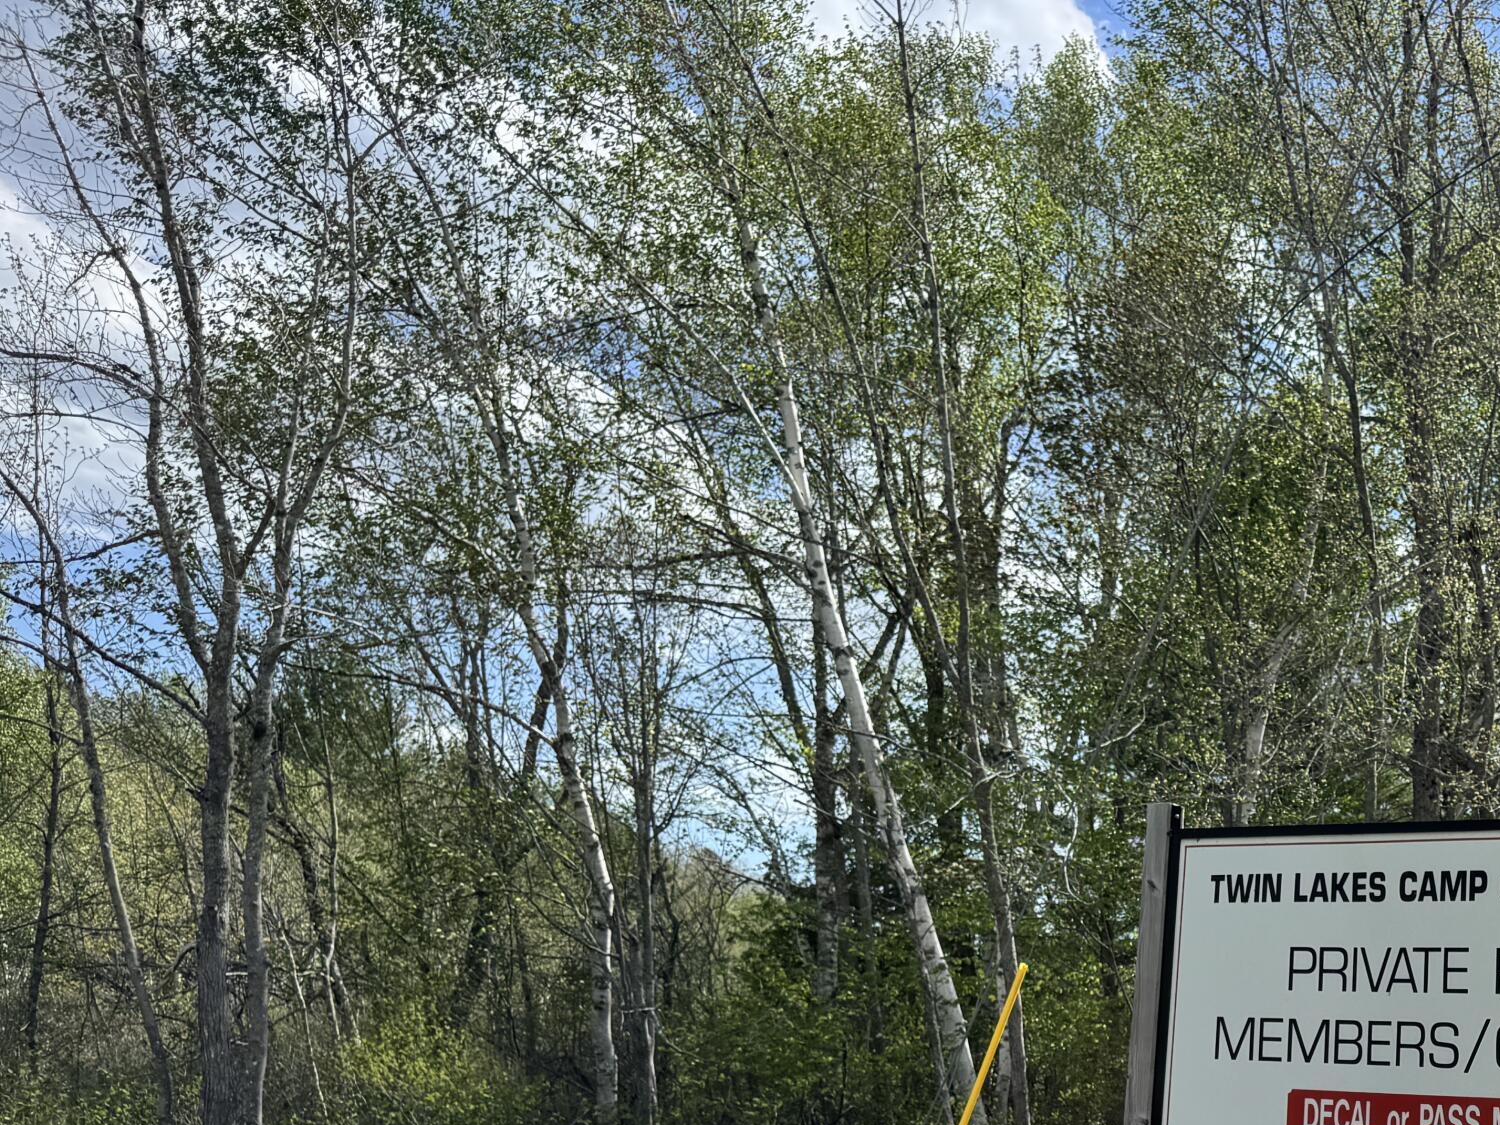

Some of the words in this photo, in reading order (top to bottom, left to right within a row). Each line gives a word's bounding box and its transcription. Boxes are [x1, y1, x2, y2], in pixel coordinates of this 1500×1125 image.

[1211, 873, 1282, 903] TWIN
[1293, 871, 1386, 903] LAKES
[1399, 870, 1488, 902] CAMP
[1288, 946, 1469, 994] PRIVATE
